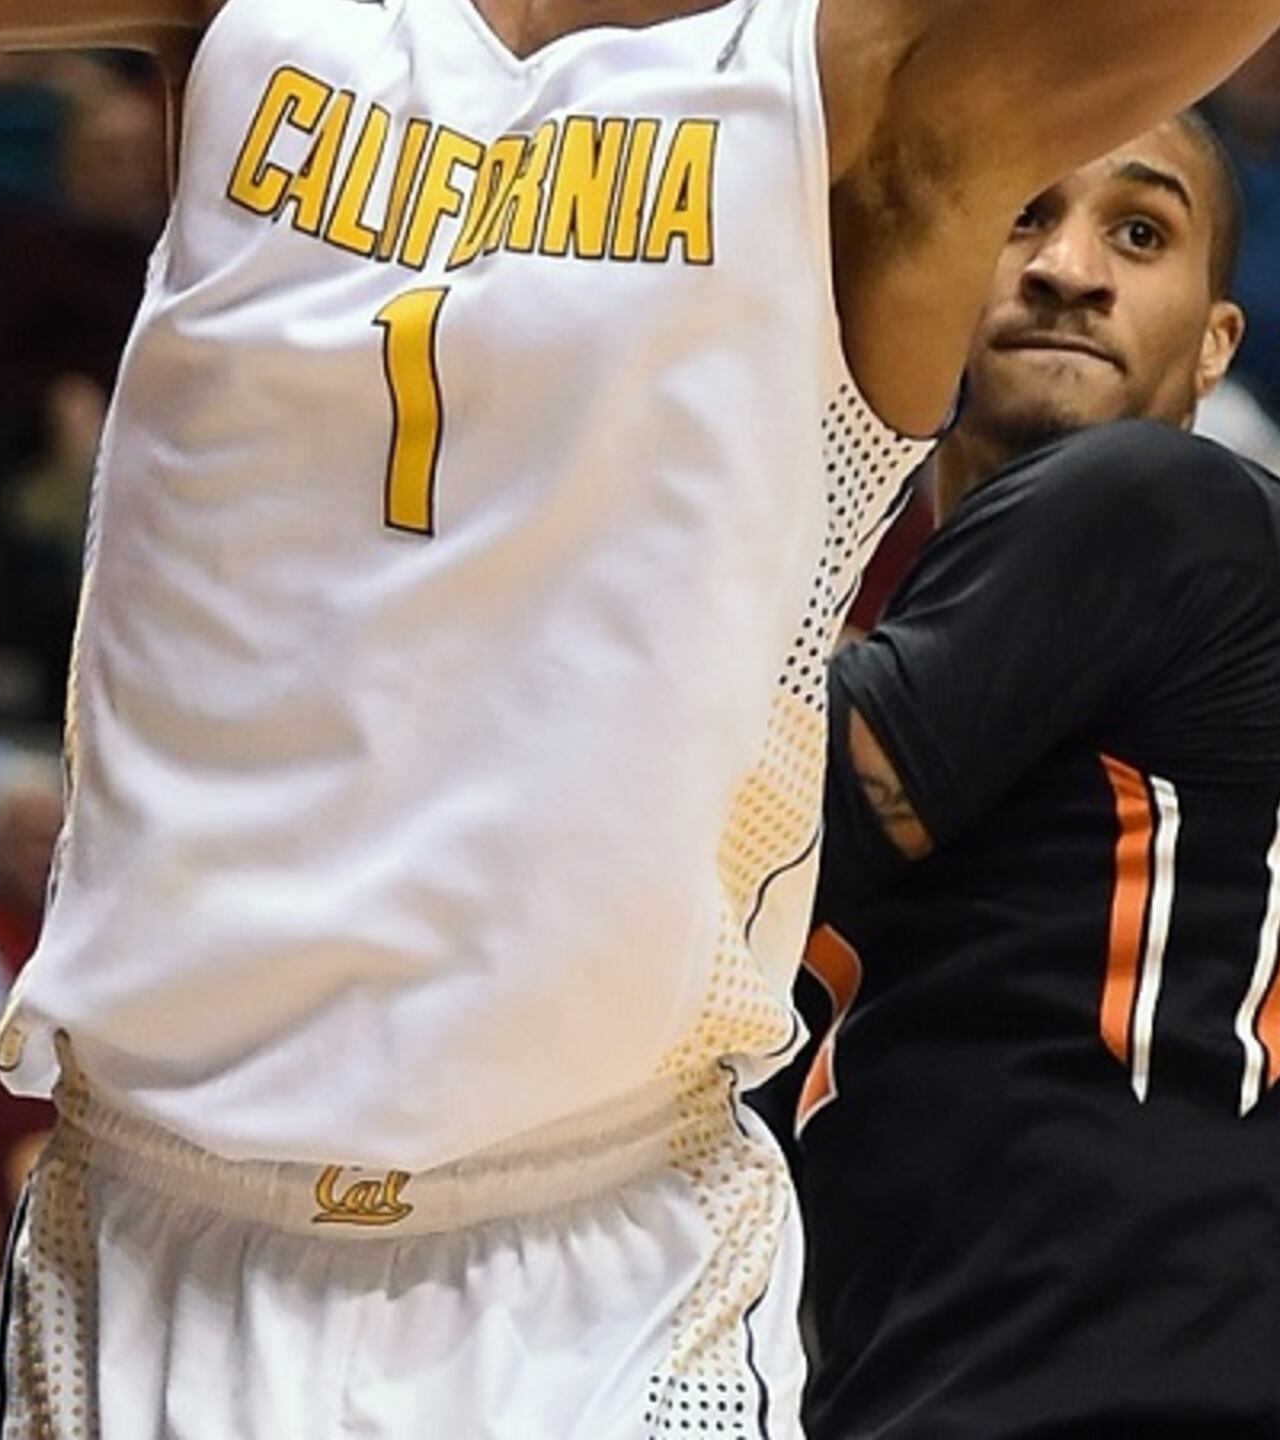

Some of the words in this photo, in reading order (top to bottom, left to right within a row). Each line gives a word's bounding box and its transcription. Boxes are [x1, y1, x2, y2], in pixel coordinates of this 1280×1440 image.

[227, 64, 720, 273] CALIFORNIA
[372, 285, 451, 538] 1
[311, 1163, 414, 1226] Cal
